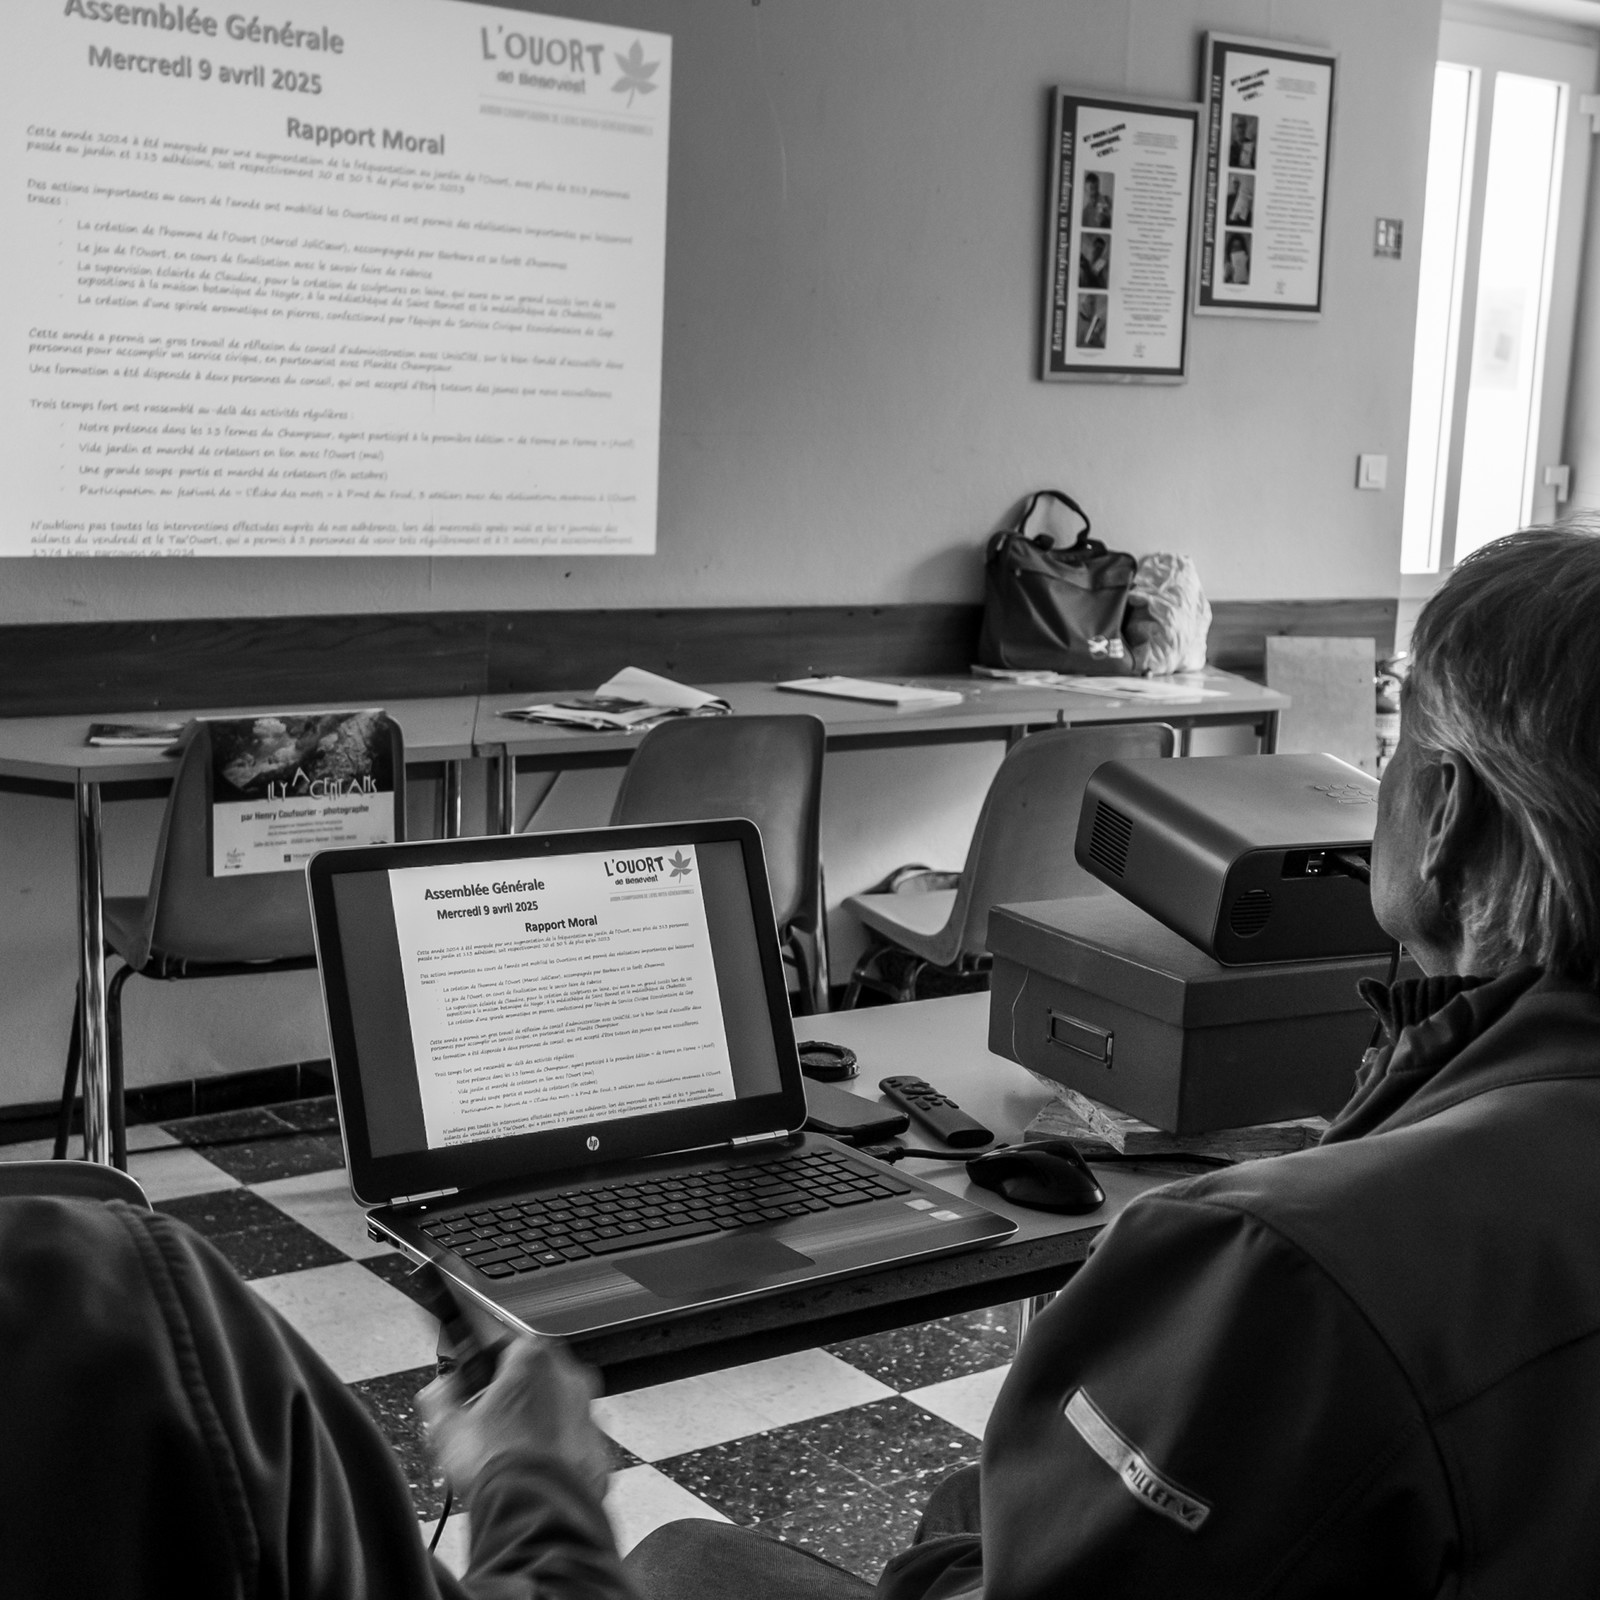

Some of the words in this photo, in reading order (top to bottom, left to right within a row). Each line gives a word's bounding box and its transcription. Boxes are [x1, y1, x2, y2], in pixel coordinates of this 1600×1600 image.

[64, 0, 218, 37] Assemblée
[226, 14, 344, 54] Générale
[481, 25, 604, 75] L'OUORT
[88, 45, 192, 79] Mercredi
[198, 59, 212, 81] 9
[218, 65, 265, 88] avril
[271, 68, 323, 95] 2025
[497, 70, 514, 84] de
[287, 117, 376, 148] Rapport
[382, 128, 445, 155] Moral
[267, 781, 278, 802] IL
[280, 782, 289, 802] Y
[292, 766, 311, 787] A
[309, 776, 345, 801] CENT
[345, 774, 377, 798] ANS
[241, 814, 253, 822] par
[255, 810, 277, 821] Henry
[323, 804, 369, 817] photographe
[604, 856, 664, 877] L'OUORT
[424, 883, 489, 900] Assemblée
[492, 878, 545, 895] Générale
[625, 874, 658, 885] Benevent
[437, 905, 481, 920] Mercredi
[483, 905, 490, 916] 9
[492, 902, 513, 915] avril
[515, 900, 539, 912] 2025
[525, 919, 566, 934] Rapport
[568, 915, 598, 928] Moral
